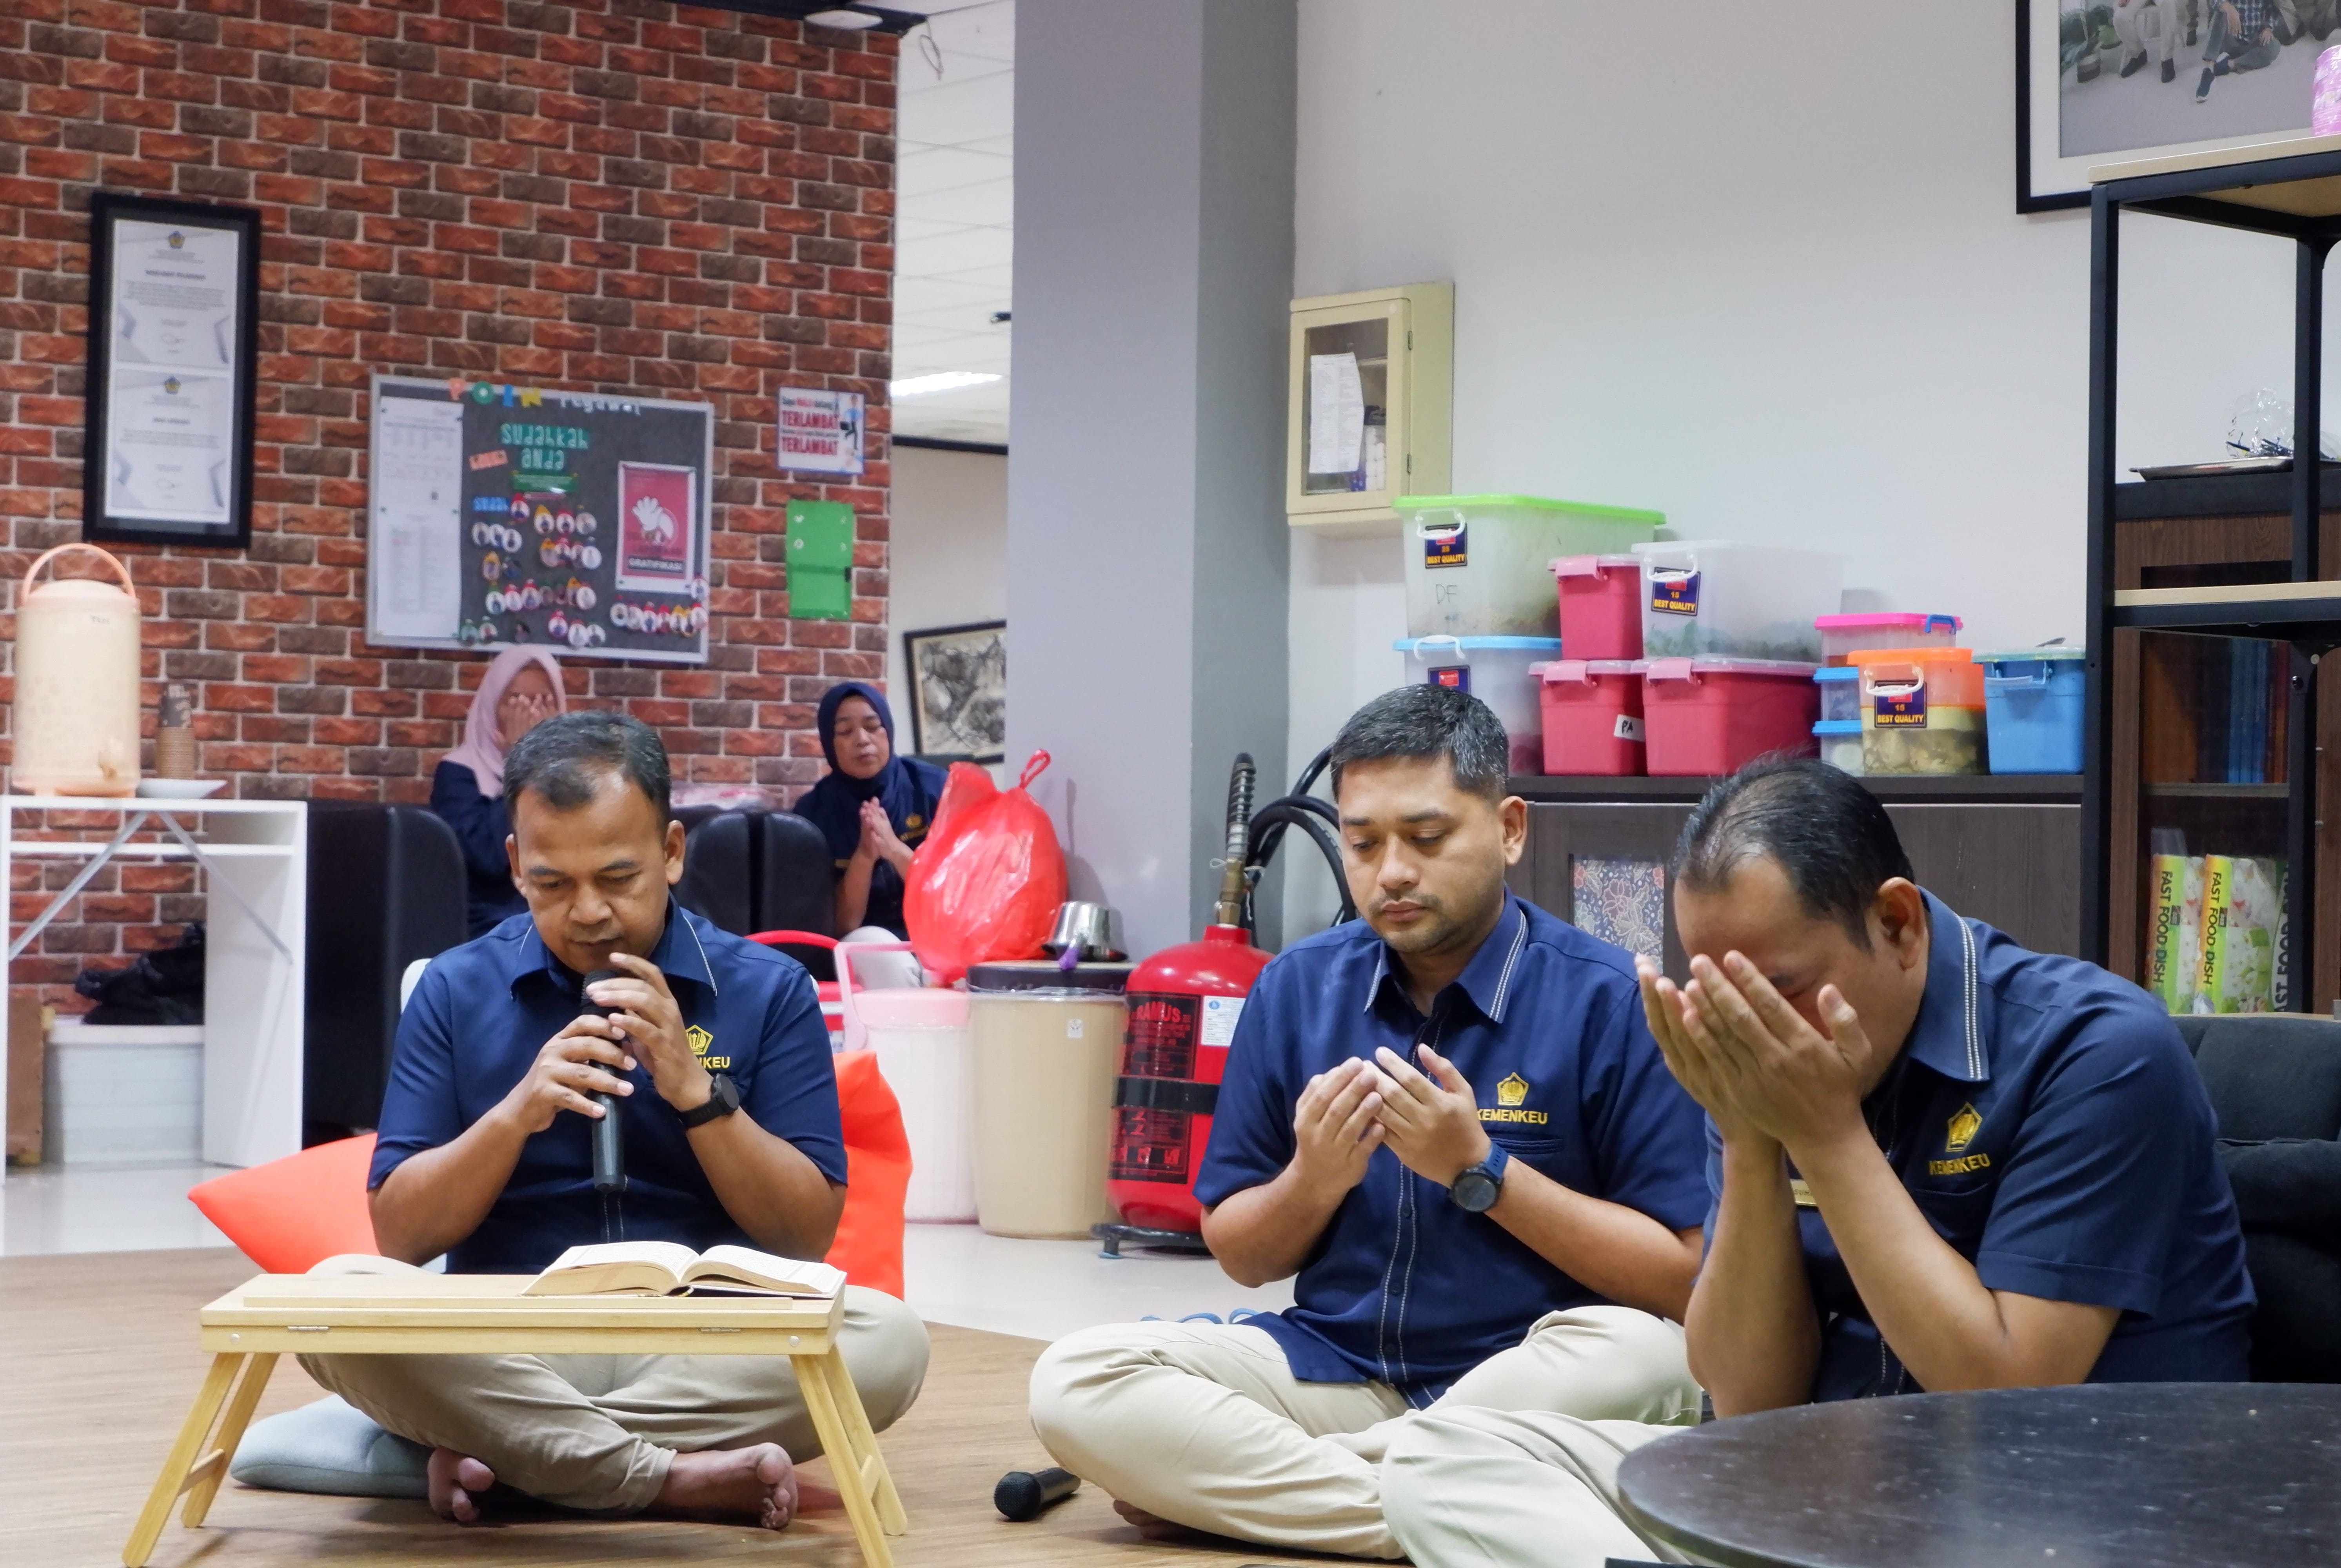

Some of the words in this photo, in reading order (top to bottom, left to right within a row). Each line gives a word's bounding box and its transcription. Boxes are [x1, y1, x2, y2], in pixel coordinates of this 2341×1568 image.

[1442, 554, 1465, 563] QUALITY
[1436, 584, 1458, 604] DF
[1654, 599, 1669, 608] BEST
[1669, 601, 1695, 611] QUALITY
[1622, 720, 1633, 733] PA
[1877, 715, 1893, 723] BEST
[1894, 714, 1924, 723] QUALITY
[2160, 871, 2173, 902] FAST
[2210, 871, 2222, 903] FAST
[2157, 906, 2170, 945] FOOD
[2207, 907, 2218, 946] FOOD
[2153, 950, 2167, 983] DISH
[2203, 951, 2215, 985] DISH
[1477, 1109, 1548, 1125] KEMENKEU
